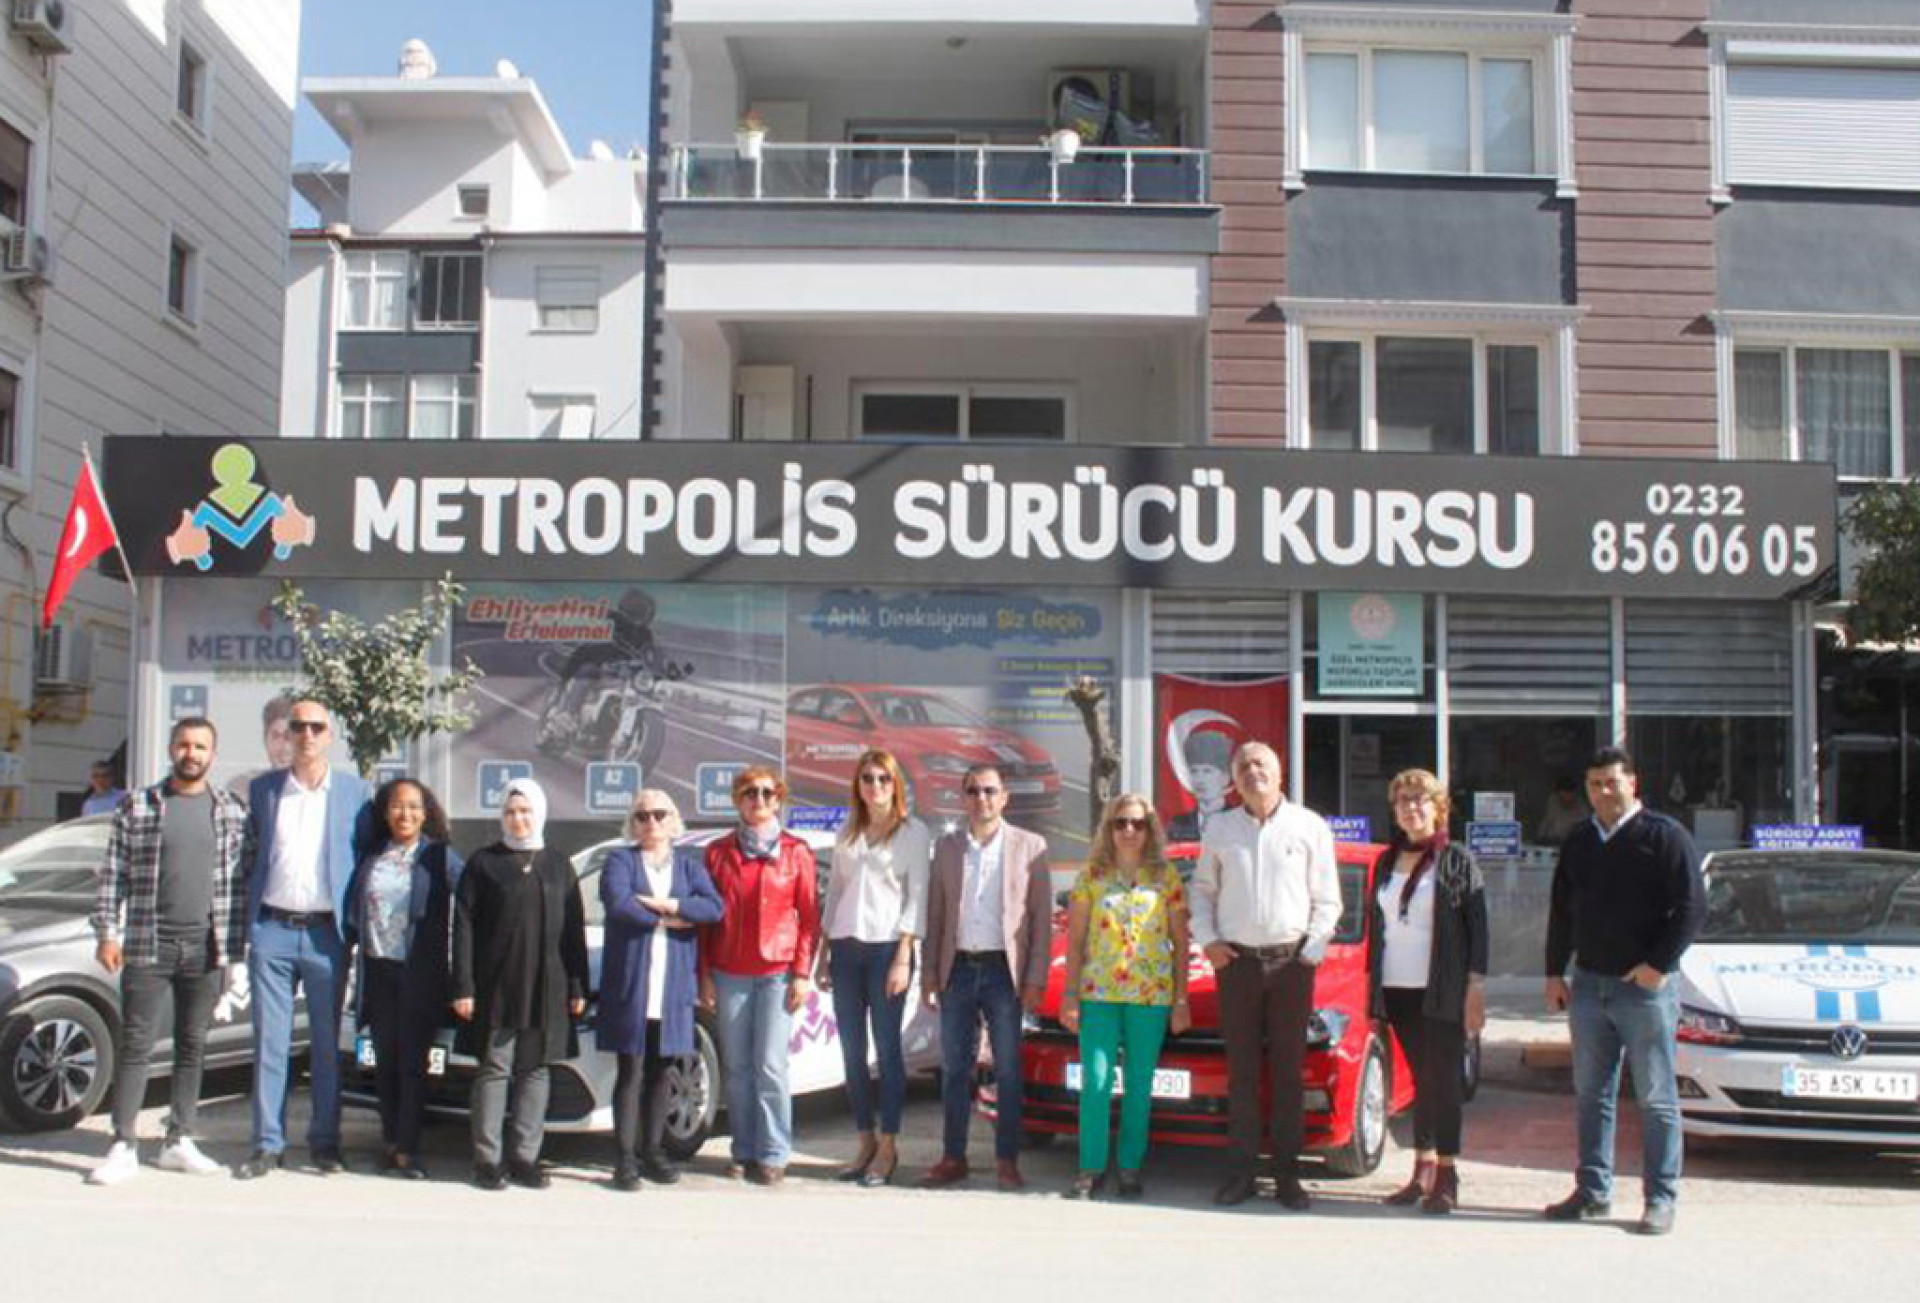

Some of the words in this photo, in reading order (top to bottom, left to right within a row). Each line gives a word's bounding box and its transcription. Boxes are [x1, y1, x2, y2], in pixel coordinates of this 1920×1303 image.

[353, 463, 858, 557] METROPOLİS
[893, 464, 1237, 563] SÜRÜCÜ
[1262, 486, 1535, 569] KURSU
[1646, 484, 1745, 516] 0232
[1591, 521, 1679, 574] 856
[1692, 523, 1751, 575] 06
[1762, 525, 1818, 577] 05
[1798, 1073, 1820, 1092] 35
[1875, 1076, 1910, 1095] 411
